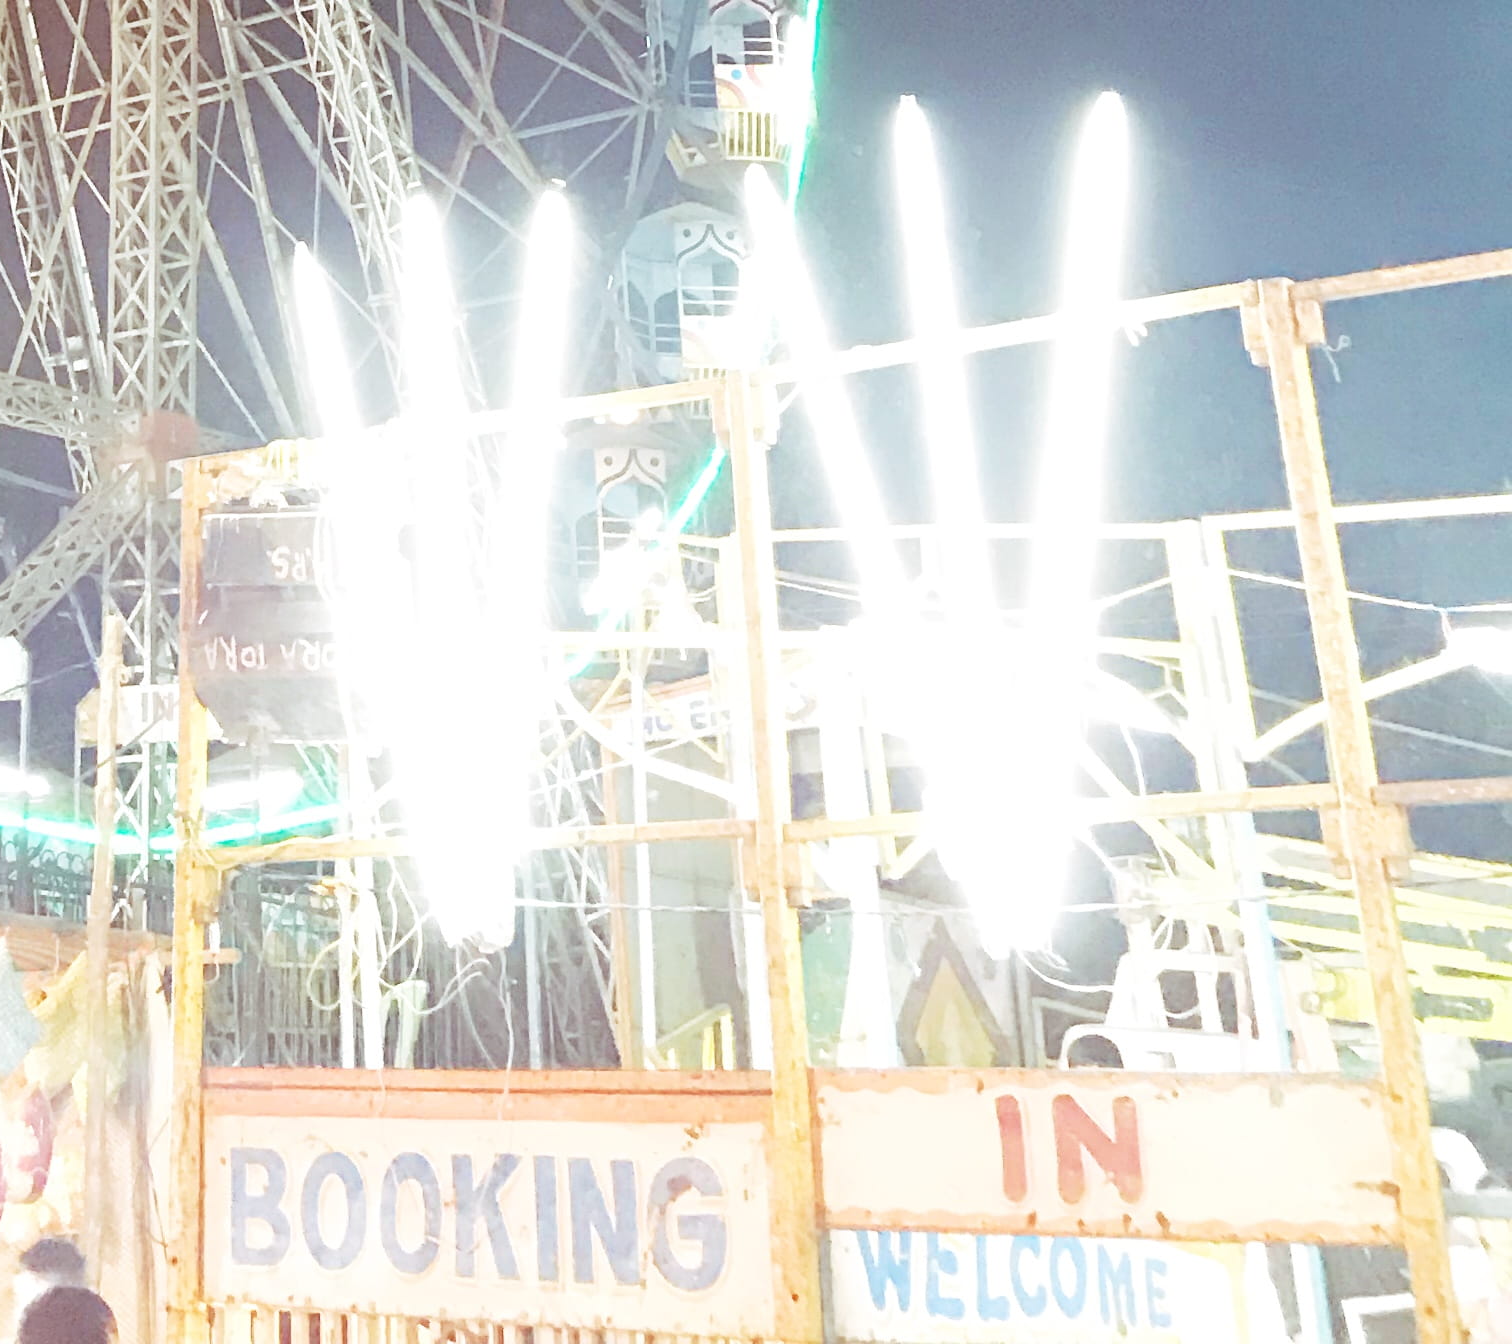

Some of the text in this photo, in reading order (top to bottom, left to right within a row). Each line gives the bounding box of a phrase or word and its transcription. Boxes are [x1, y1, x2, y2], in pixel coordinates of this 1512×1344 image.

[204, 634, 269, 672] TORA
[141, 690, 175, 723] IN
[994, 1093, 1145, 1205] IN
[227, 1146, 730, 1293] BOOKING
[855, 1230, 1174, 1329] WELCOME
